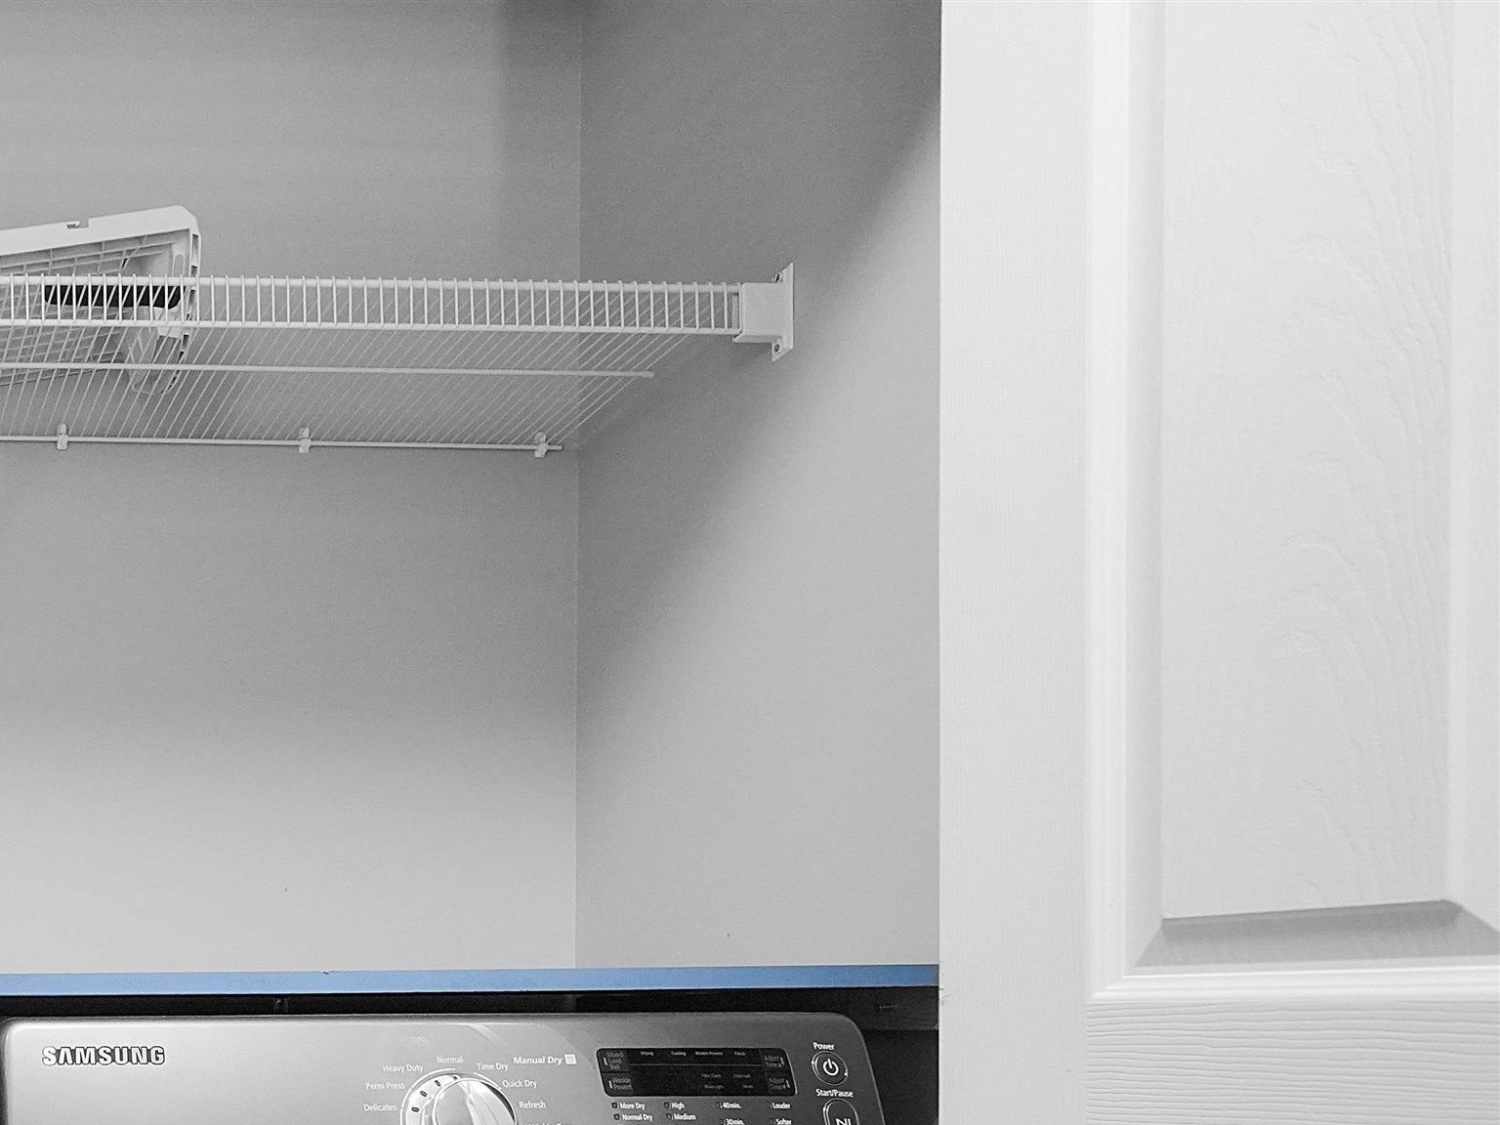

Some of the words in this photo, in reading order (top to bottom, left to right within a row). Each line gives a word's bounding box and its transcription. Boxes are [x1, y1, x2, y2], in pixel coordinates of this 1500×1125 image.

[41, 1046, 166, 1066] SAMSUNG
[436, 1055, 464, 1064] Normal
[513, 1056, 546, 1064] Manual
[547, 1056, 563, 1066] Dry
[382, 1065, 405, 1073] Heavy
[405, 1064, 424, 1073] Duty
[477, 1062, 495, 1070] Time
[495, 1062, 509, 1072] Dry
[365, 1082, 385, 1090] Perm
[386, 1082, 406, 1090] Press
[502, 1079, 523, 1088] Quick
[524, 1079, 537, 1089] Dry
[363, 1103, 398, 1112] Delicates
[518, 1100, 547, 1109] Refresh
[619, 1102, 635, 1110] More
[635, 1102, 646, 1111] Dry
[671, 1102, 685, 1110] High
[621, 1113, 643, 1121] Normal
[642, 1114, 653, 1122] Dry
